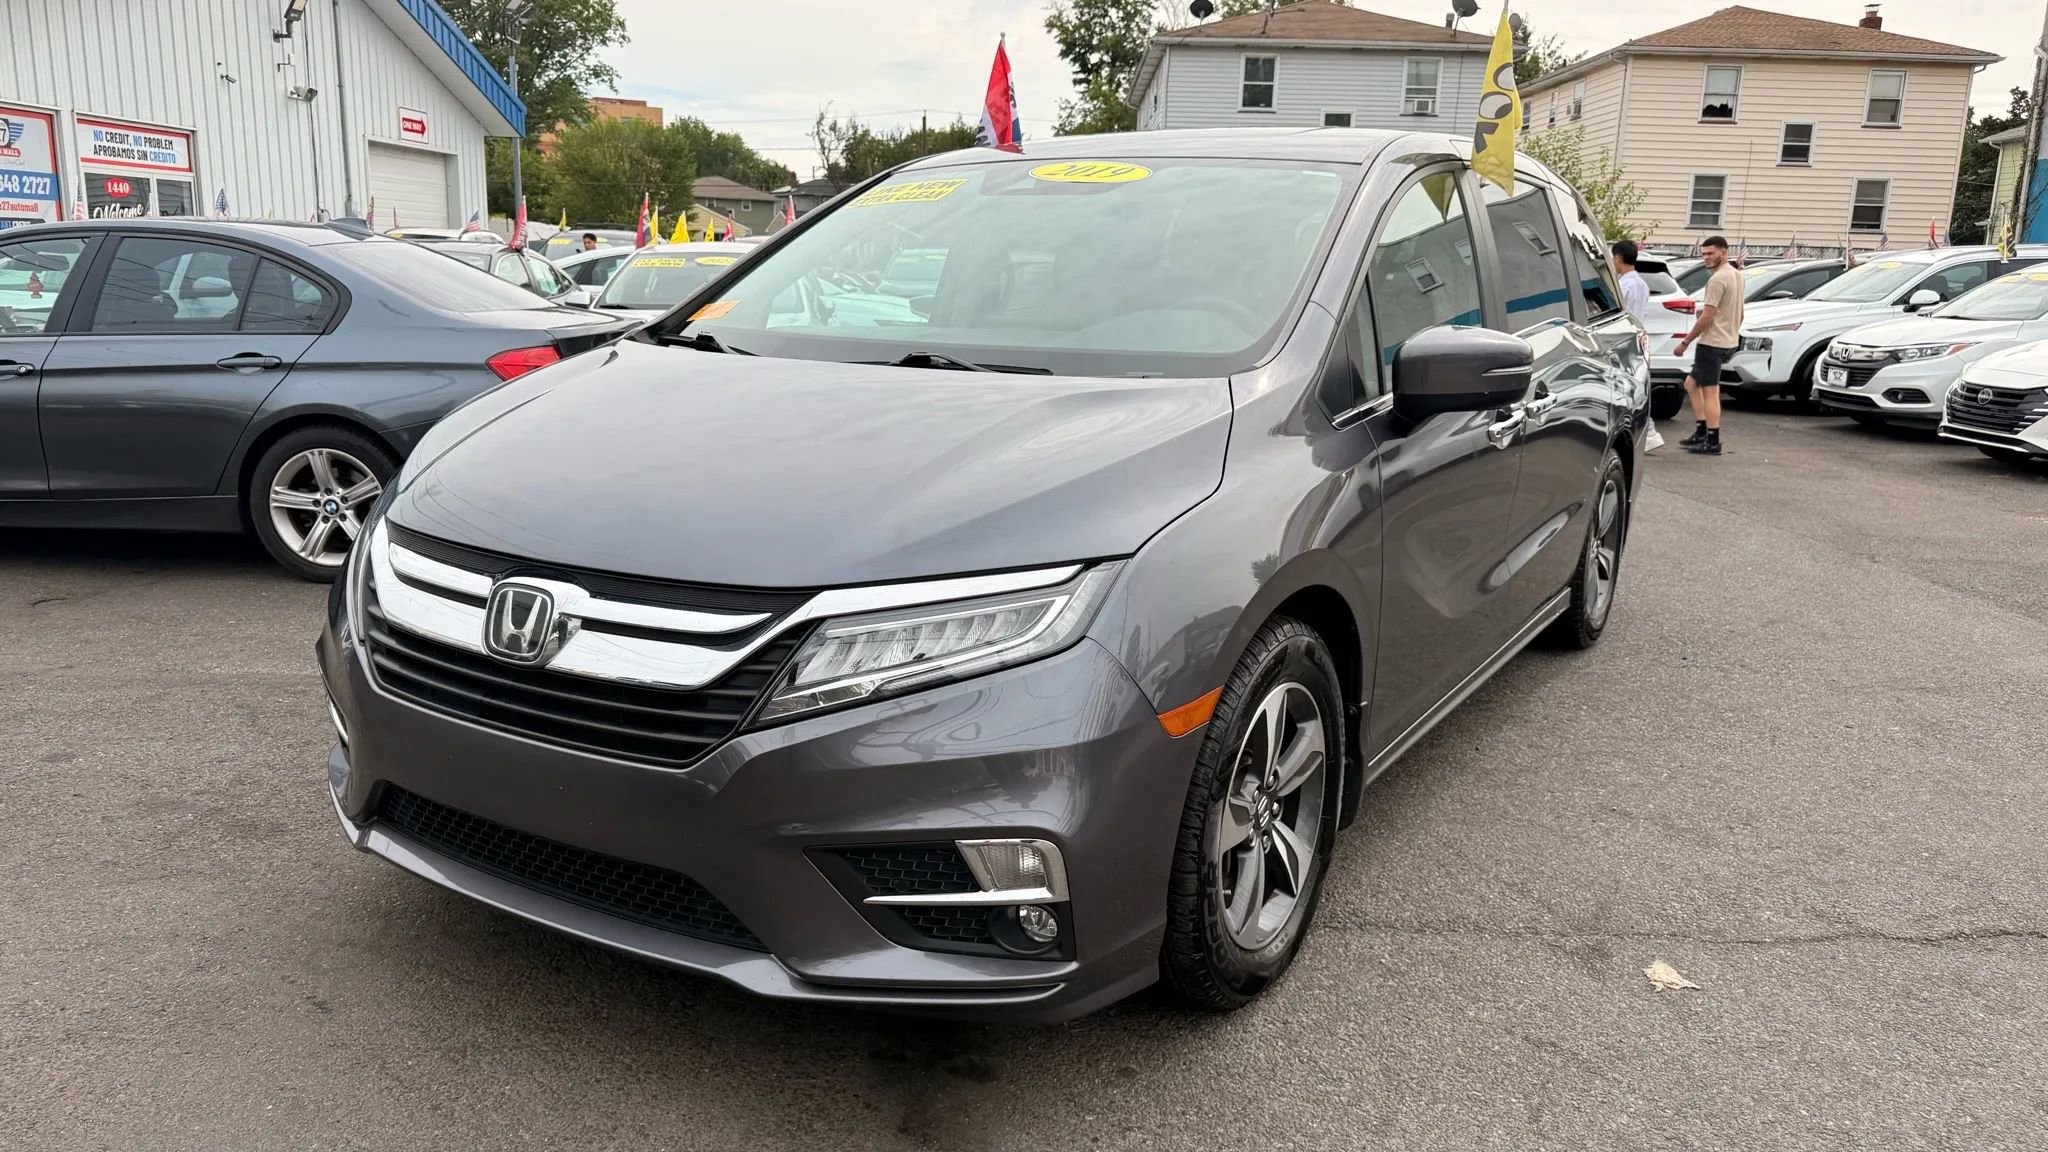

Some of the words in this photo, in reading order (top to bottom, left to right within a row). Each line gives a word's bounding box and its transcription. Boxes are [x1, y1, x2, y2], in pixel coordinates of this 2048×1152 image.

[93, 129, 104, 142] NO
[105, 131, 132, 147] CREDIT,
[133, 135, 142, 147] NO
[144, 137, 174, 151] PROBLEM
[93, 144, 135, 160] APROBAMOS
[136, 150, 148, 161] SIN
[1042, 164, 1136, 178] 2019
[22, 175, 51, 195] 2727
[107, 181, 130, 194] 1440
[909, 180, 964, 192] NEW
[896, 189, 951, 201] CLEAN
[93, 203, 144, 219] Welcome
